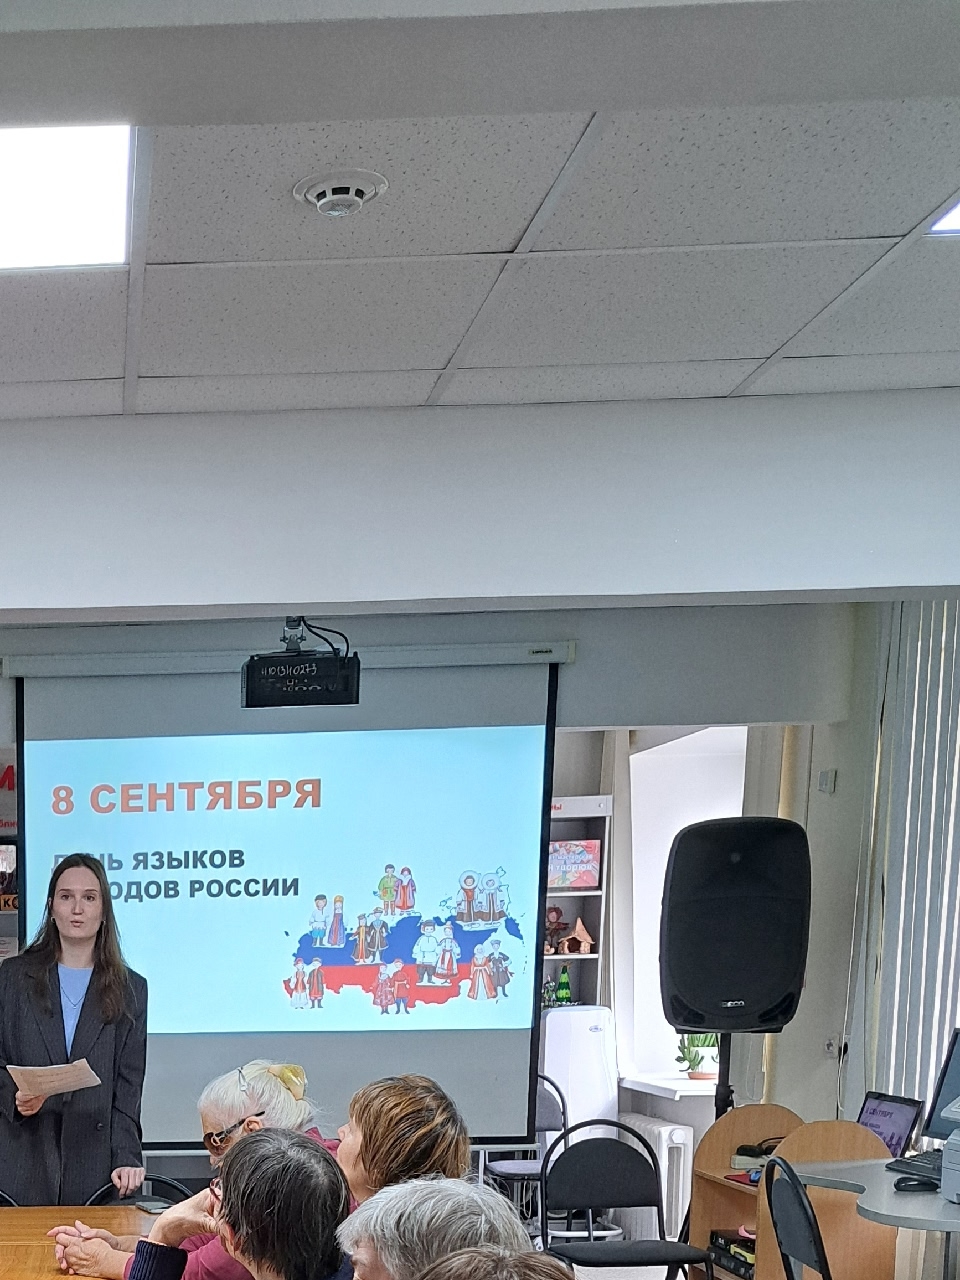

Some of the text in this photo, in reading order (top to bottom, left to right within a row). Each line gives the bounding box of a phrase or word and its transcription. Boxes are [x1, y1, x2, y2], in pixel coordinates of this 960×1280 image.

[51, 778, 322, 815] 8 СЕНТЯБРЯ
[132, 849, 246, 871] ЯЗЫКОВ
[189, 878, 300, 899] РОССИИ
